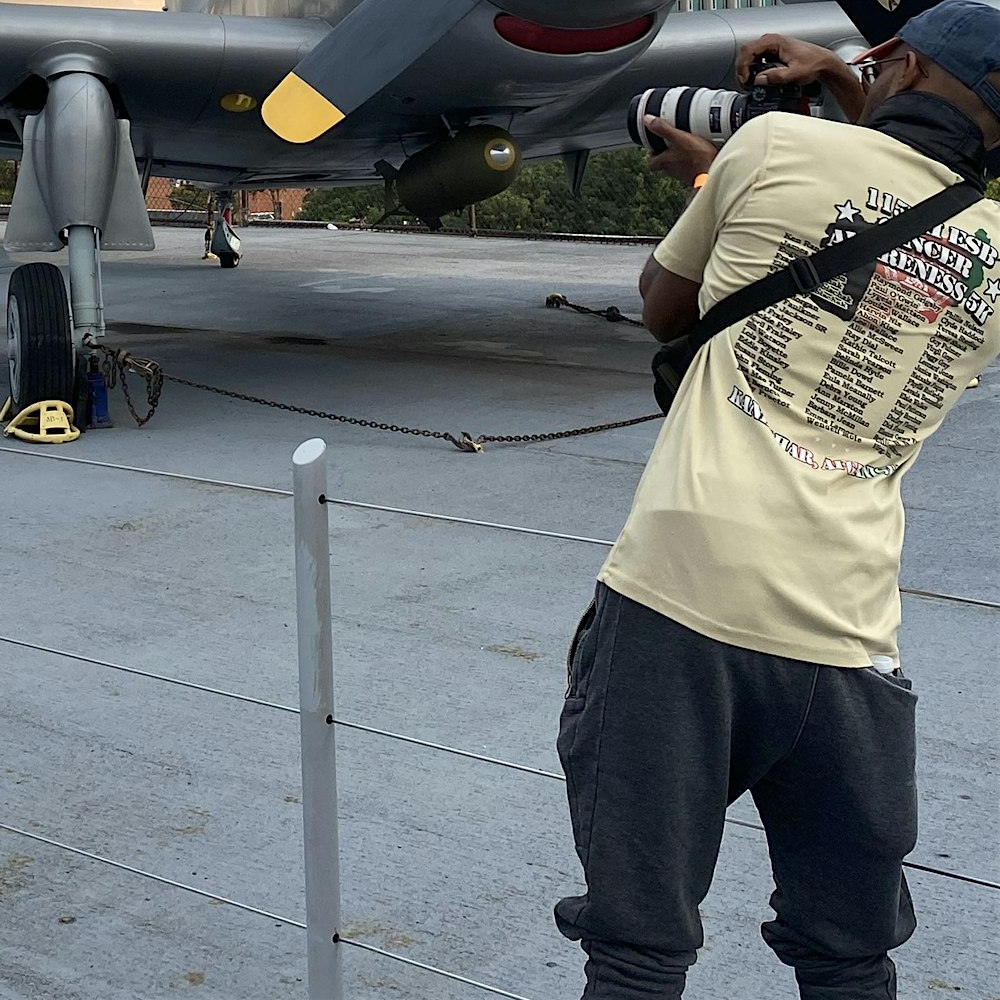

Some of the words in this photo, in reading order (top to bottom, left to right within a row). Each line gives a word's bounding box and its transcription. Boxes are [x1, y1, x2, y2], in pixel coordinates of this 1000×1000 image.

[949, 226, 999, 269] ESB
[871, 282, 888, 294] Paul
[872, 274, 912, 299] Raymond
[780, 305, 813, 328] Jackson
[815, 323, 828, 334] SR
[783, 298, 820, 322] Faulkner
[863, 296, 889, 313] Louise
[891, 309, 920, 328] Wallace
[964, 291, 995, 326] 5K
[766, 325, 792, 344] Fraley
[776, 321, 802, 340] Fraley
[848, 322, 866, 335] Allie
[868, 332, 904, 354] McSween
[869, 324, 898, 342] Wallace
[879, 321, 899, 336] King
[940, 316, 958, 331] Clyde
[841, 337, 867, 354] Kathie
[868, 350, 897, 368] Talcott
[844, 329, 861, 342] Ray
[862, 338, 878, 350] Dial
[734, 342, 757, 359] Susan
[755, 356, 780, 376] Story
[830, 357, 850, 371] Billie
[851, 368, 873, 383] Dowd
[835, 351, 863, 369] Belinda
[864, 366, 884, 381] Hyde
[838, 344, 861, 359] Sarah
[862, 356, 892, 375] Pearson
[768, 380, 794, 398] Turner
[823, 372, 841, 385] Eula
[826, 364, 855, 383] Pamela
[855, 379, 885, 398] Barnett
[815, 386, 831, 398] Ann
[832, 395, 864, 415] Marston
[820, 379, 842, 395] Debra
[842, 391, 868, 409] Young
[804, 408, 829, 424] Emma
[808, 400, 837, 418] Barbara
[837, 415, 856, 429] Jean
[810, 393, 836, 411] Jenny
[835, 406, 871, 427] McMillan
